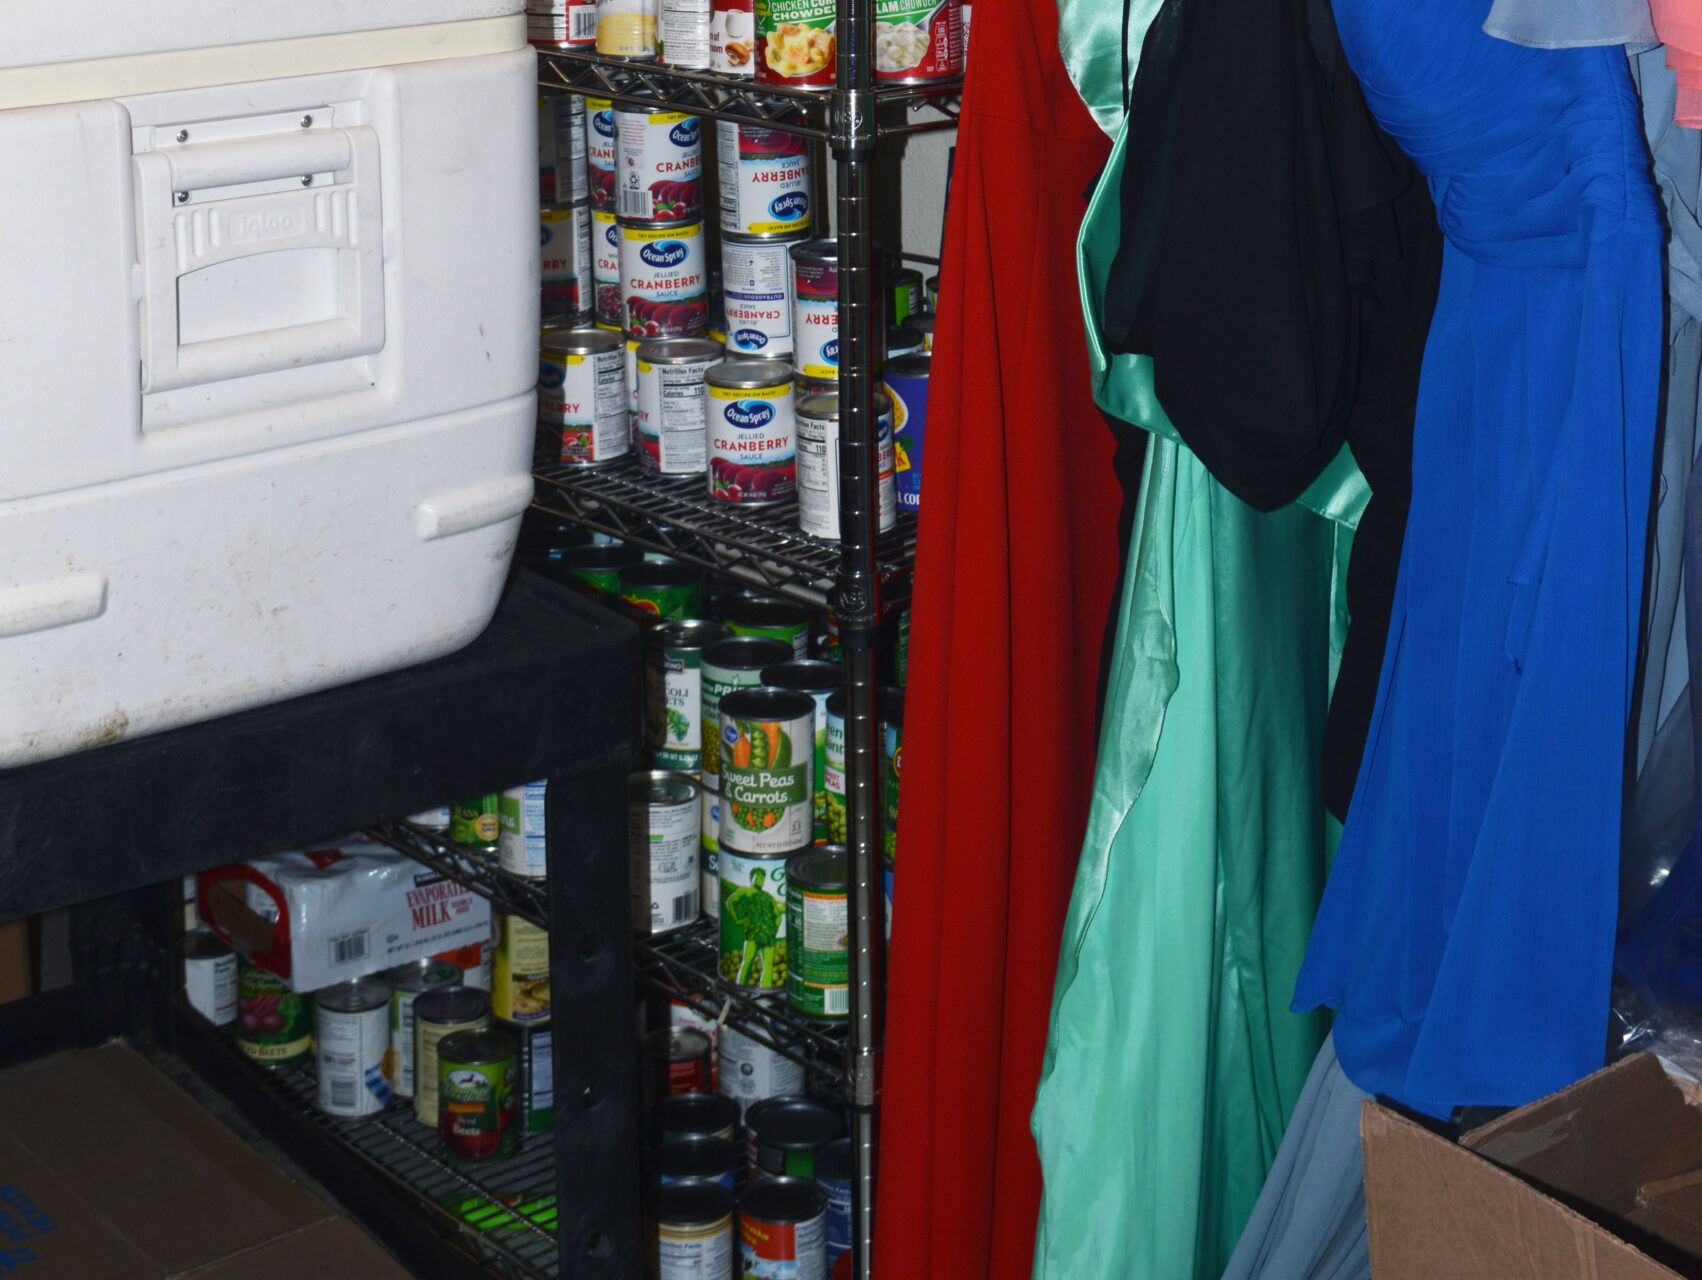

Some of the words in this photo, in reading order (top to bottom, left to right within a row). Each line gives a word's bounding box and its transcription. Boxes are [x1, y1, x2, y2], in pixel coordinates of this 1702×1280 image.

[642, 249, 664, 263] Ocean
[664, 247, 684, 264] Spray
[630, 273, 701, 291] CRANBERRY
[653, 270, 680, 280] JELLIED
[656, 290, 678, 298] SAUCE
[726, 408, 749, 424] Ocean
[749, 408, 771, 425] Spray
[714, 435, 789, 453] CRANBERRY
[737, 431, 765, 440] JELLIED
[739, 453, 763, 461] SAUCE
[721, 763, 757, 788] Sweet
[759, 772, 795, 788] Peas
[412, 900, 452, 932] MILK
